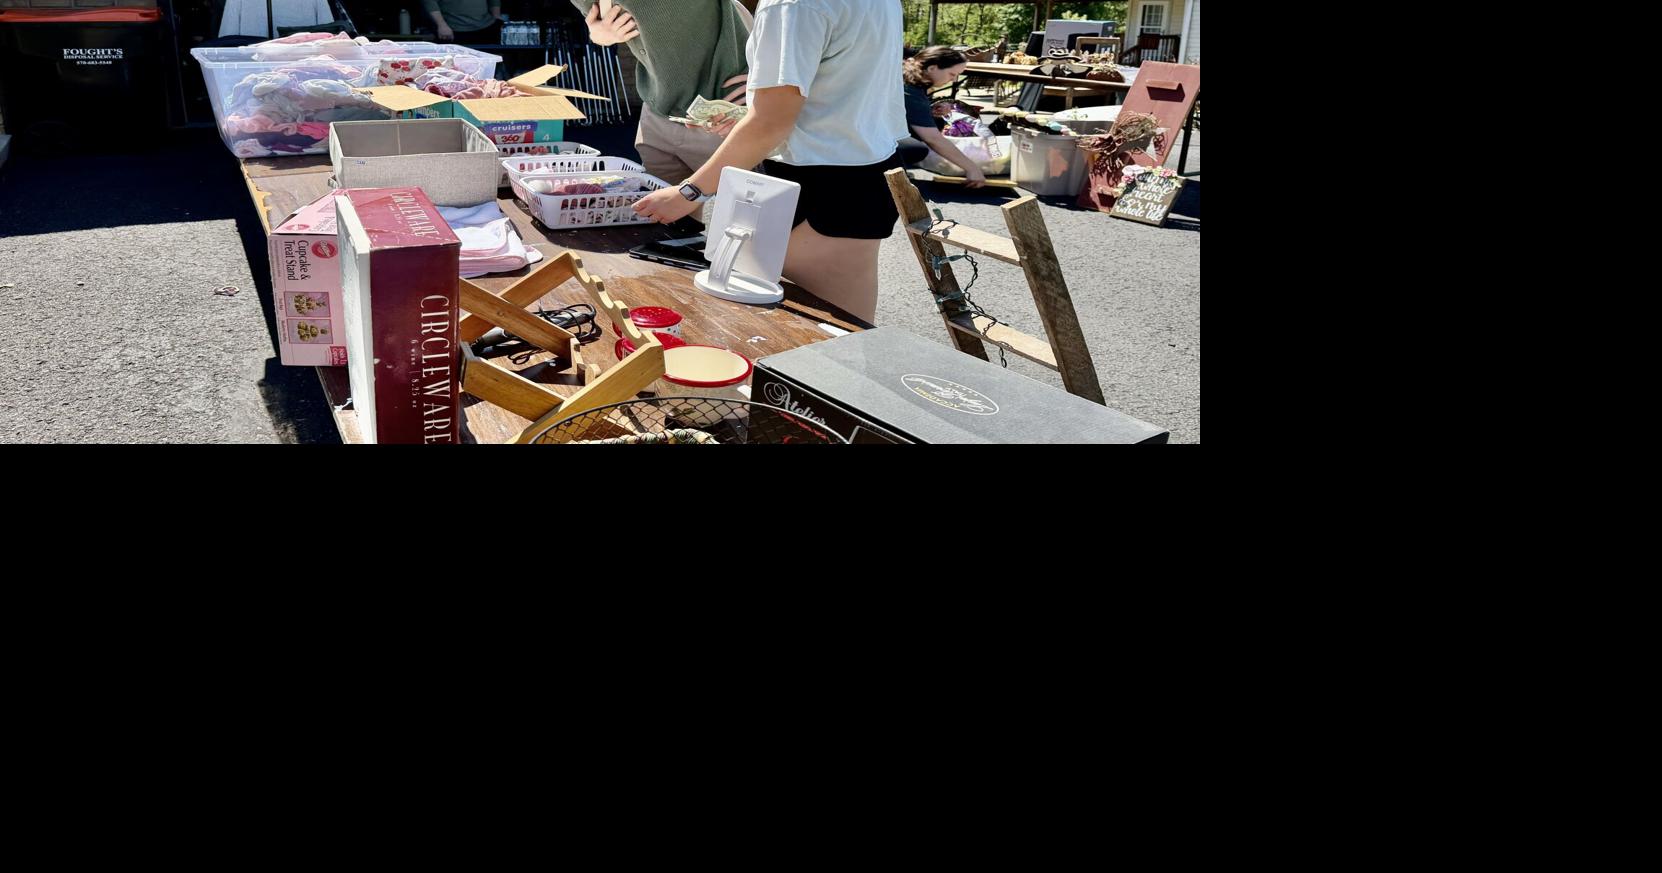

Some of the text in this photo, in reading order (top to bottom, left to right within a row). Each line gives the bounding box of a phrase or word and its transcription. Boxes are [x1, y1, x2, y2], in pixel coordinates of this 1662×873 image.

[492, 124, 531, 132] cruisers
[543, 133, 551, 141] 4
[1131, 187, 1164, 203] heart
[1139, 183, 1171, 194] whole
[391, 191, 440, 237] CIRCLEWARE
[1145, 202, 1168, 212] my
[284, 240, 299, 281] Treat Stand
[295, 240, 311, 272] Cupcake
[420, 294, 452, 445] CIRCLEWARE
[763, 381, 826, 426] Atelier
